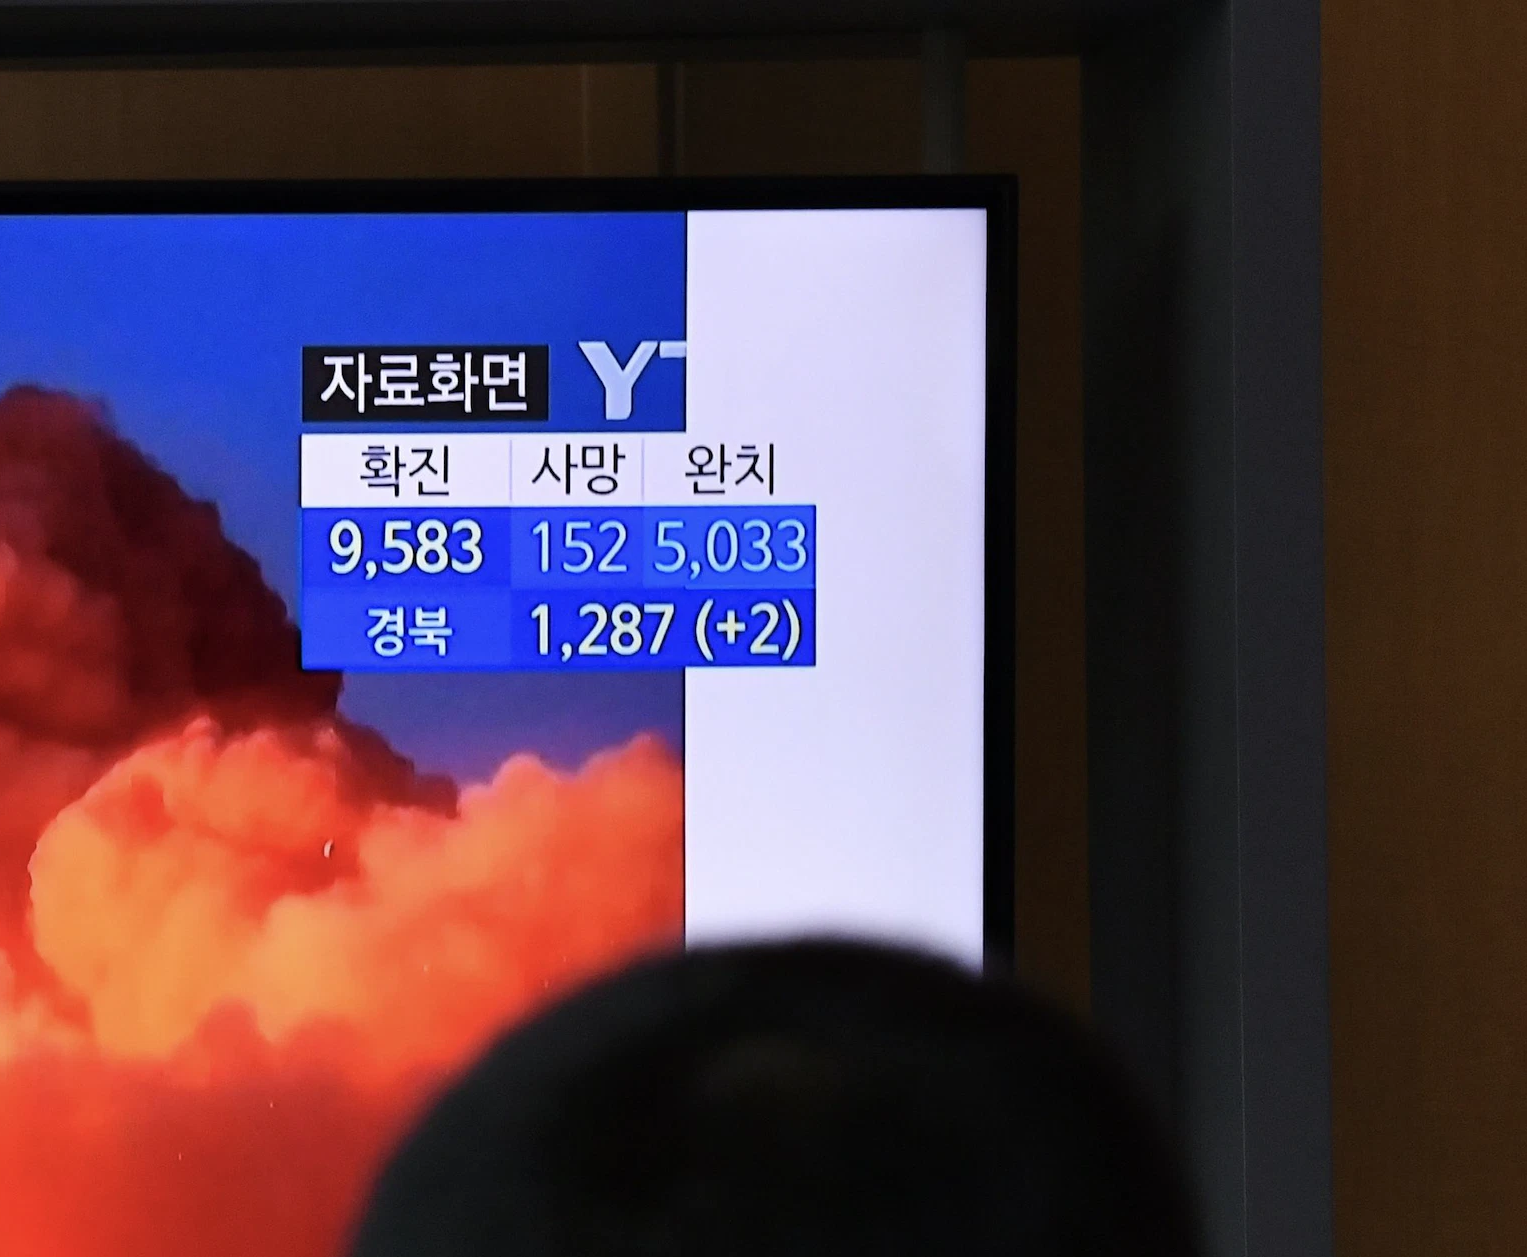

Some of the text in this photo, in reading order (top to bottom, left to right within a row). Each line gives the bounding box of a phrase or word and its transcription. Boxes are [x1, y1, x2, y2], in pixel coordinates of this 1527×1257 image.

[320, 352, 527, 414] 자료화면
[578, 340, 684, 420] Y
[360, 443, 774, 497] 확진 사망 완치
[329, 519, 807, 580] 9,583 152 5,033
[367, 599, 800, 662] 경북 1,287 (+2)
